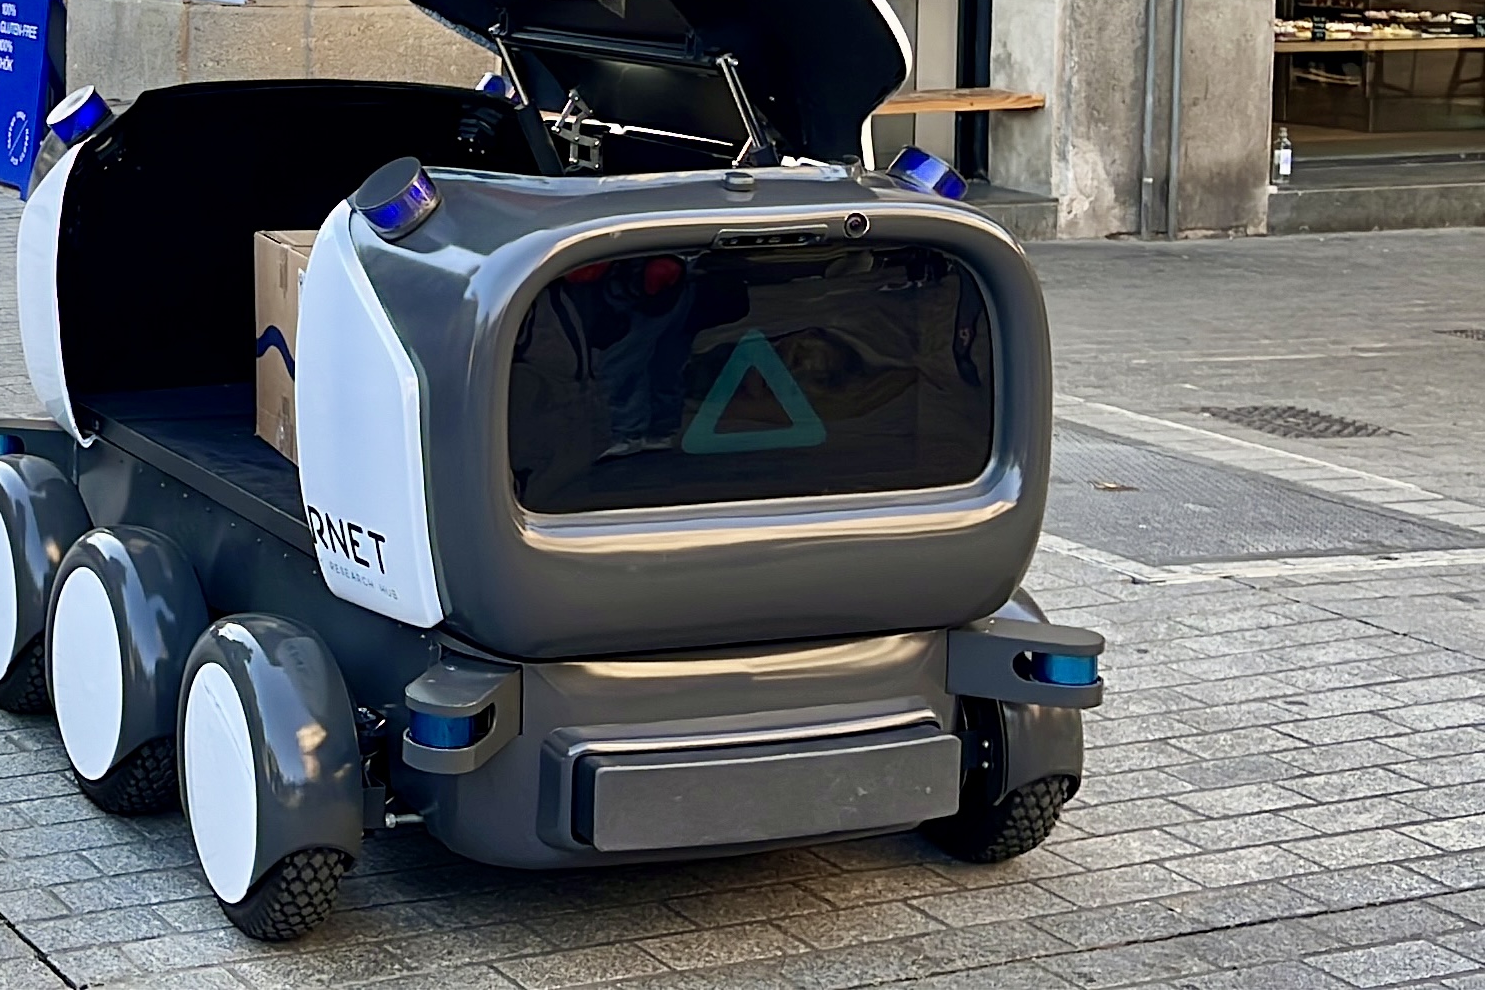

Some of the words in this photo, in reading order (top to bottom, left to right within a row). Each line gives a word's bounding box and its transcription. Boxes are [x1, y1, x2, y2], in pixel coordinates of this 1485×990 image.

[307, 505, 386, 575] RNET
[329, 560, 374, 587] RESEARCH
[378, 583, 399, 601] HUB
